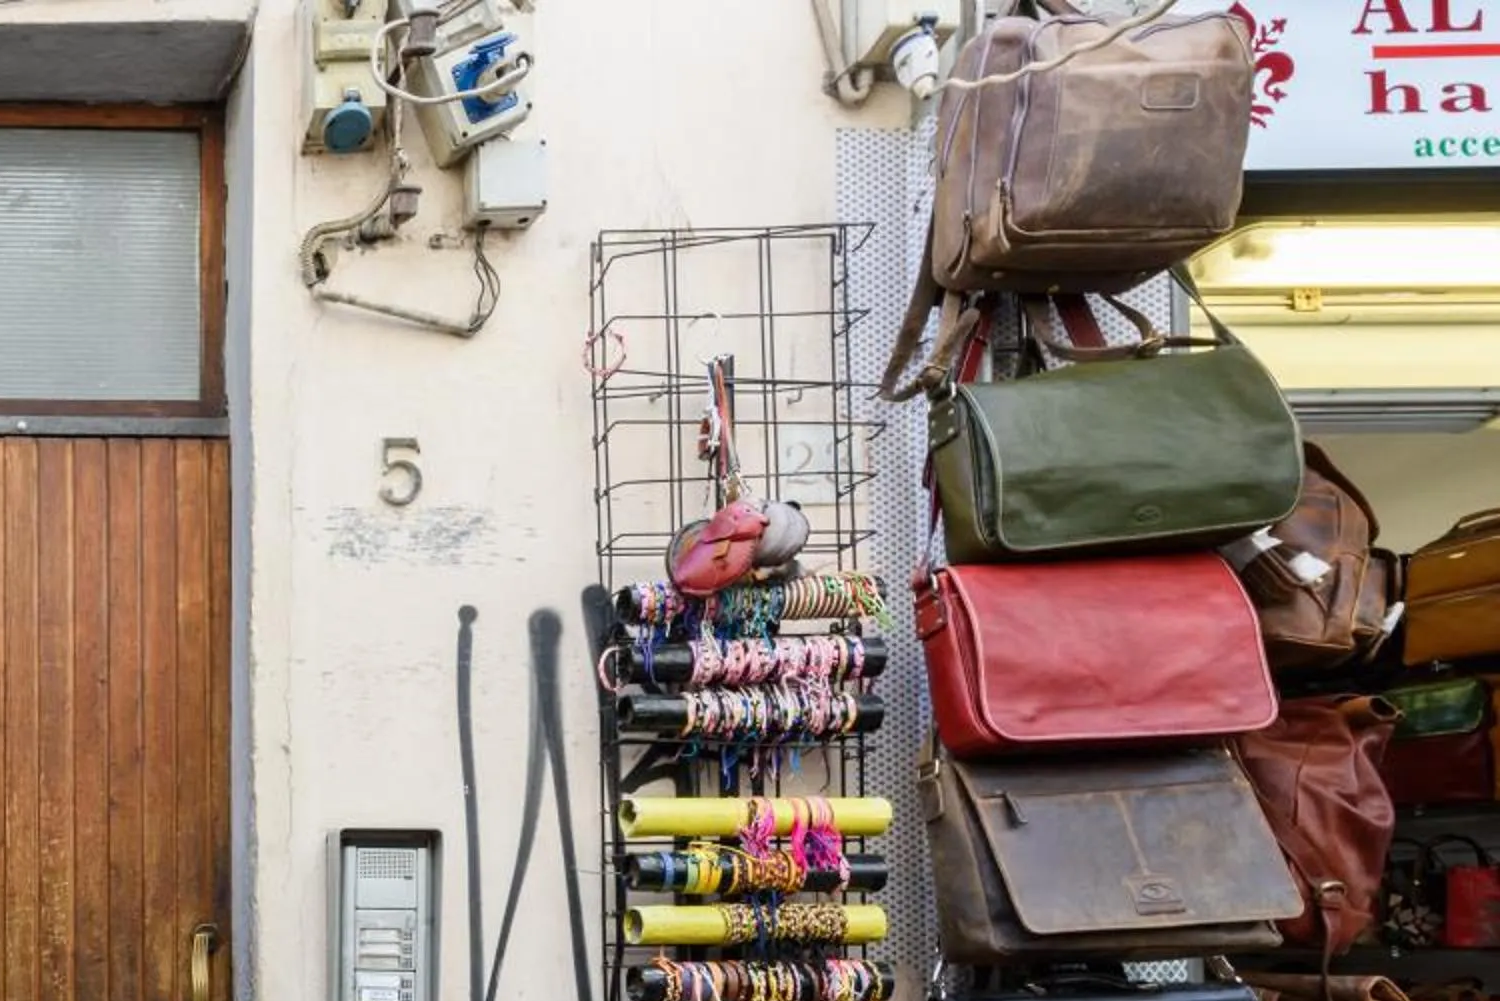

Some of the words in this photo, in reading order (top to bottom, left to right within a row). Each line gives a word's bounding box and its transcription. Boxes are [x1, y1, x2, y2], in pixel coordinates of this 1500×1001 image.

[1364, 69, 1493, 115] ha
[1414, 136, 1500, 157] acce
[379, 437, 422, 507] 5
